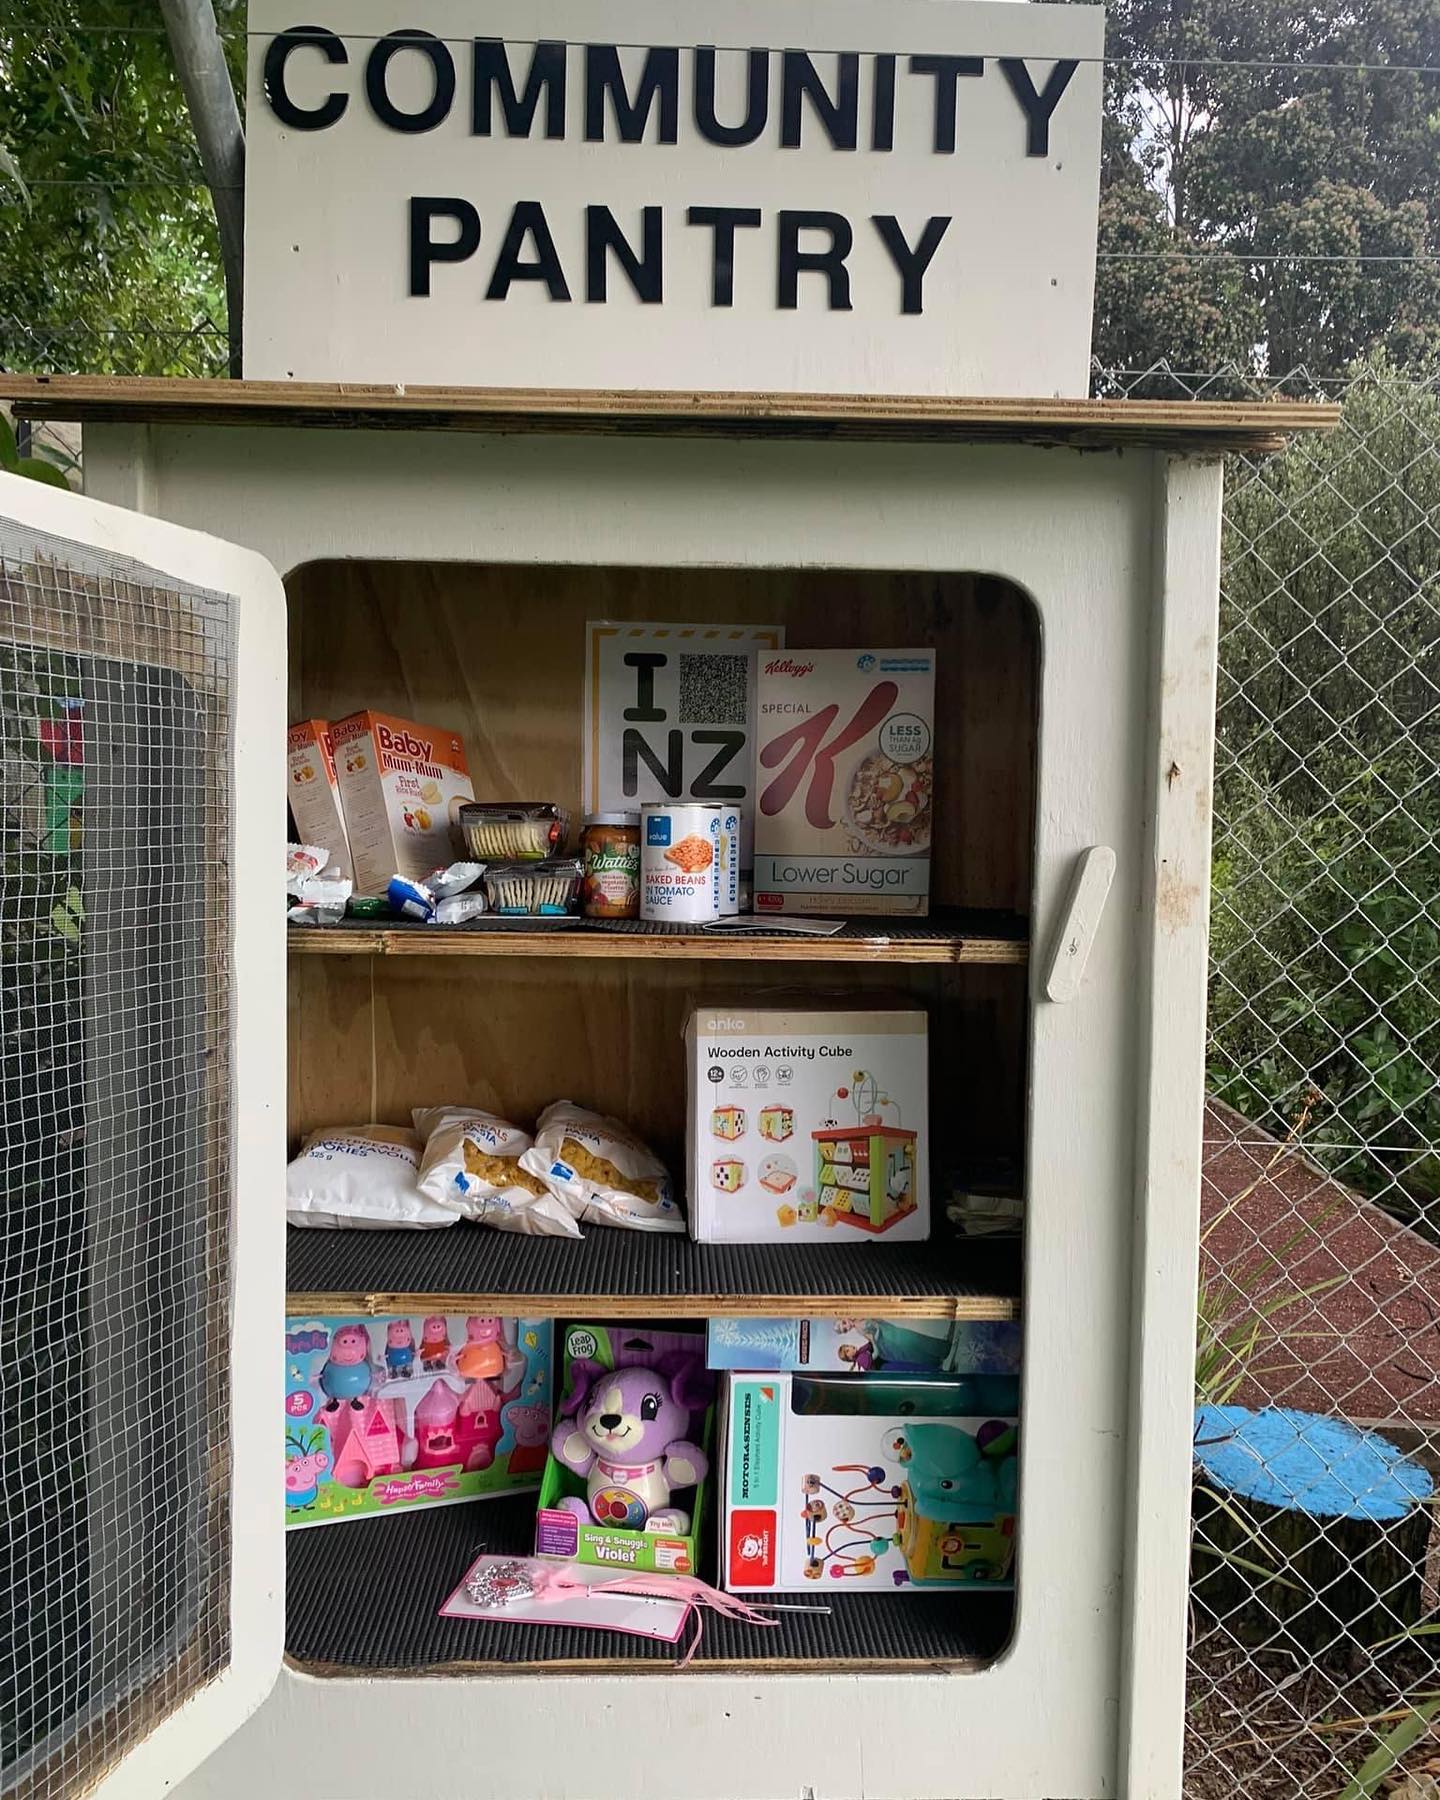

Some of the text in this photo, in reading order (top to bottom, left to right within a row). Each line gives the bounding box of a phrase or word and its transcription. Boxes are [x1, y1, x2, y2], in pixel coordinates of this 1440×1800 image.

[263, 26, 1079, 158] COMMUNITY
[408, 196, 953, 315] PANTRY
[765, 659, 815, 677] Kellogg's
[623, 652, 668, 722] I
[762, 704, 812, 714] SPECIAL
[334, 720, 363, 739] Baby
[889, 725, 921, 736] LESS
[377, 724, 433, 763] Baby
[889, 736, 911, 744] THAN
[759, 680, 899, 829] K
[888, 743, 921, 753] SUGAR
[381, 753, 443, 780] Mum-Mum
[622, 728, 747, 798] NZ
[398, 776, 420, 789] First
[649, 833, 667, 841] value
[592, 854, 638, 870] Wattie's
[646, 874, 706, 885] BAKED BEANS
[772, 862, 909, 889] Lower Sugar
[645, 886, 695, 896] IN TOMATO
[645, 896, 673, 905] SAUCE
[707, 1017, 745, 1030] anko
[707, 1045, 853, 1060] Wooden Activity Cube
[463, 1127, 496, 1146] PASTA
[570, 1335, 591, 1347] Leap
[572, 1344, 593, 1355] Frog
[293, 1394, 304, 1405] 5
[290, 1404, 308, 1412] PCS
[415, 1479, 444, 1491] Family
[584, 1533, 604, 1544] Sing
[613, 1537, 648, 1550] Snuggle
[595, 1546, 637, 1563] Violet
